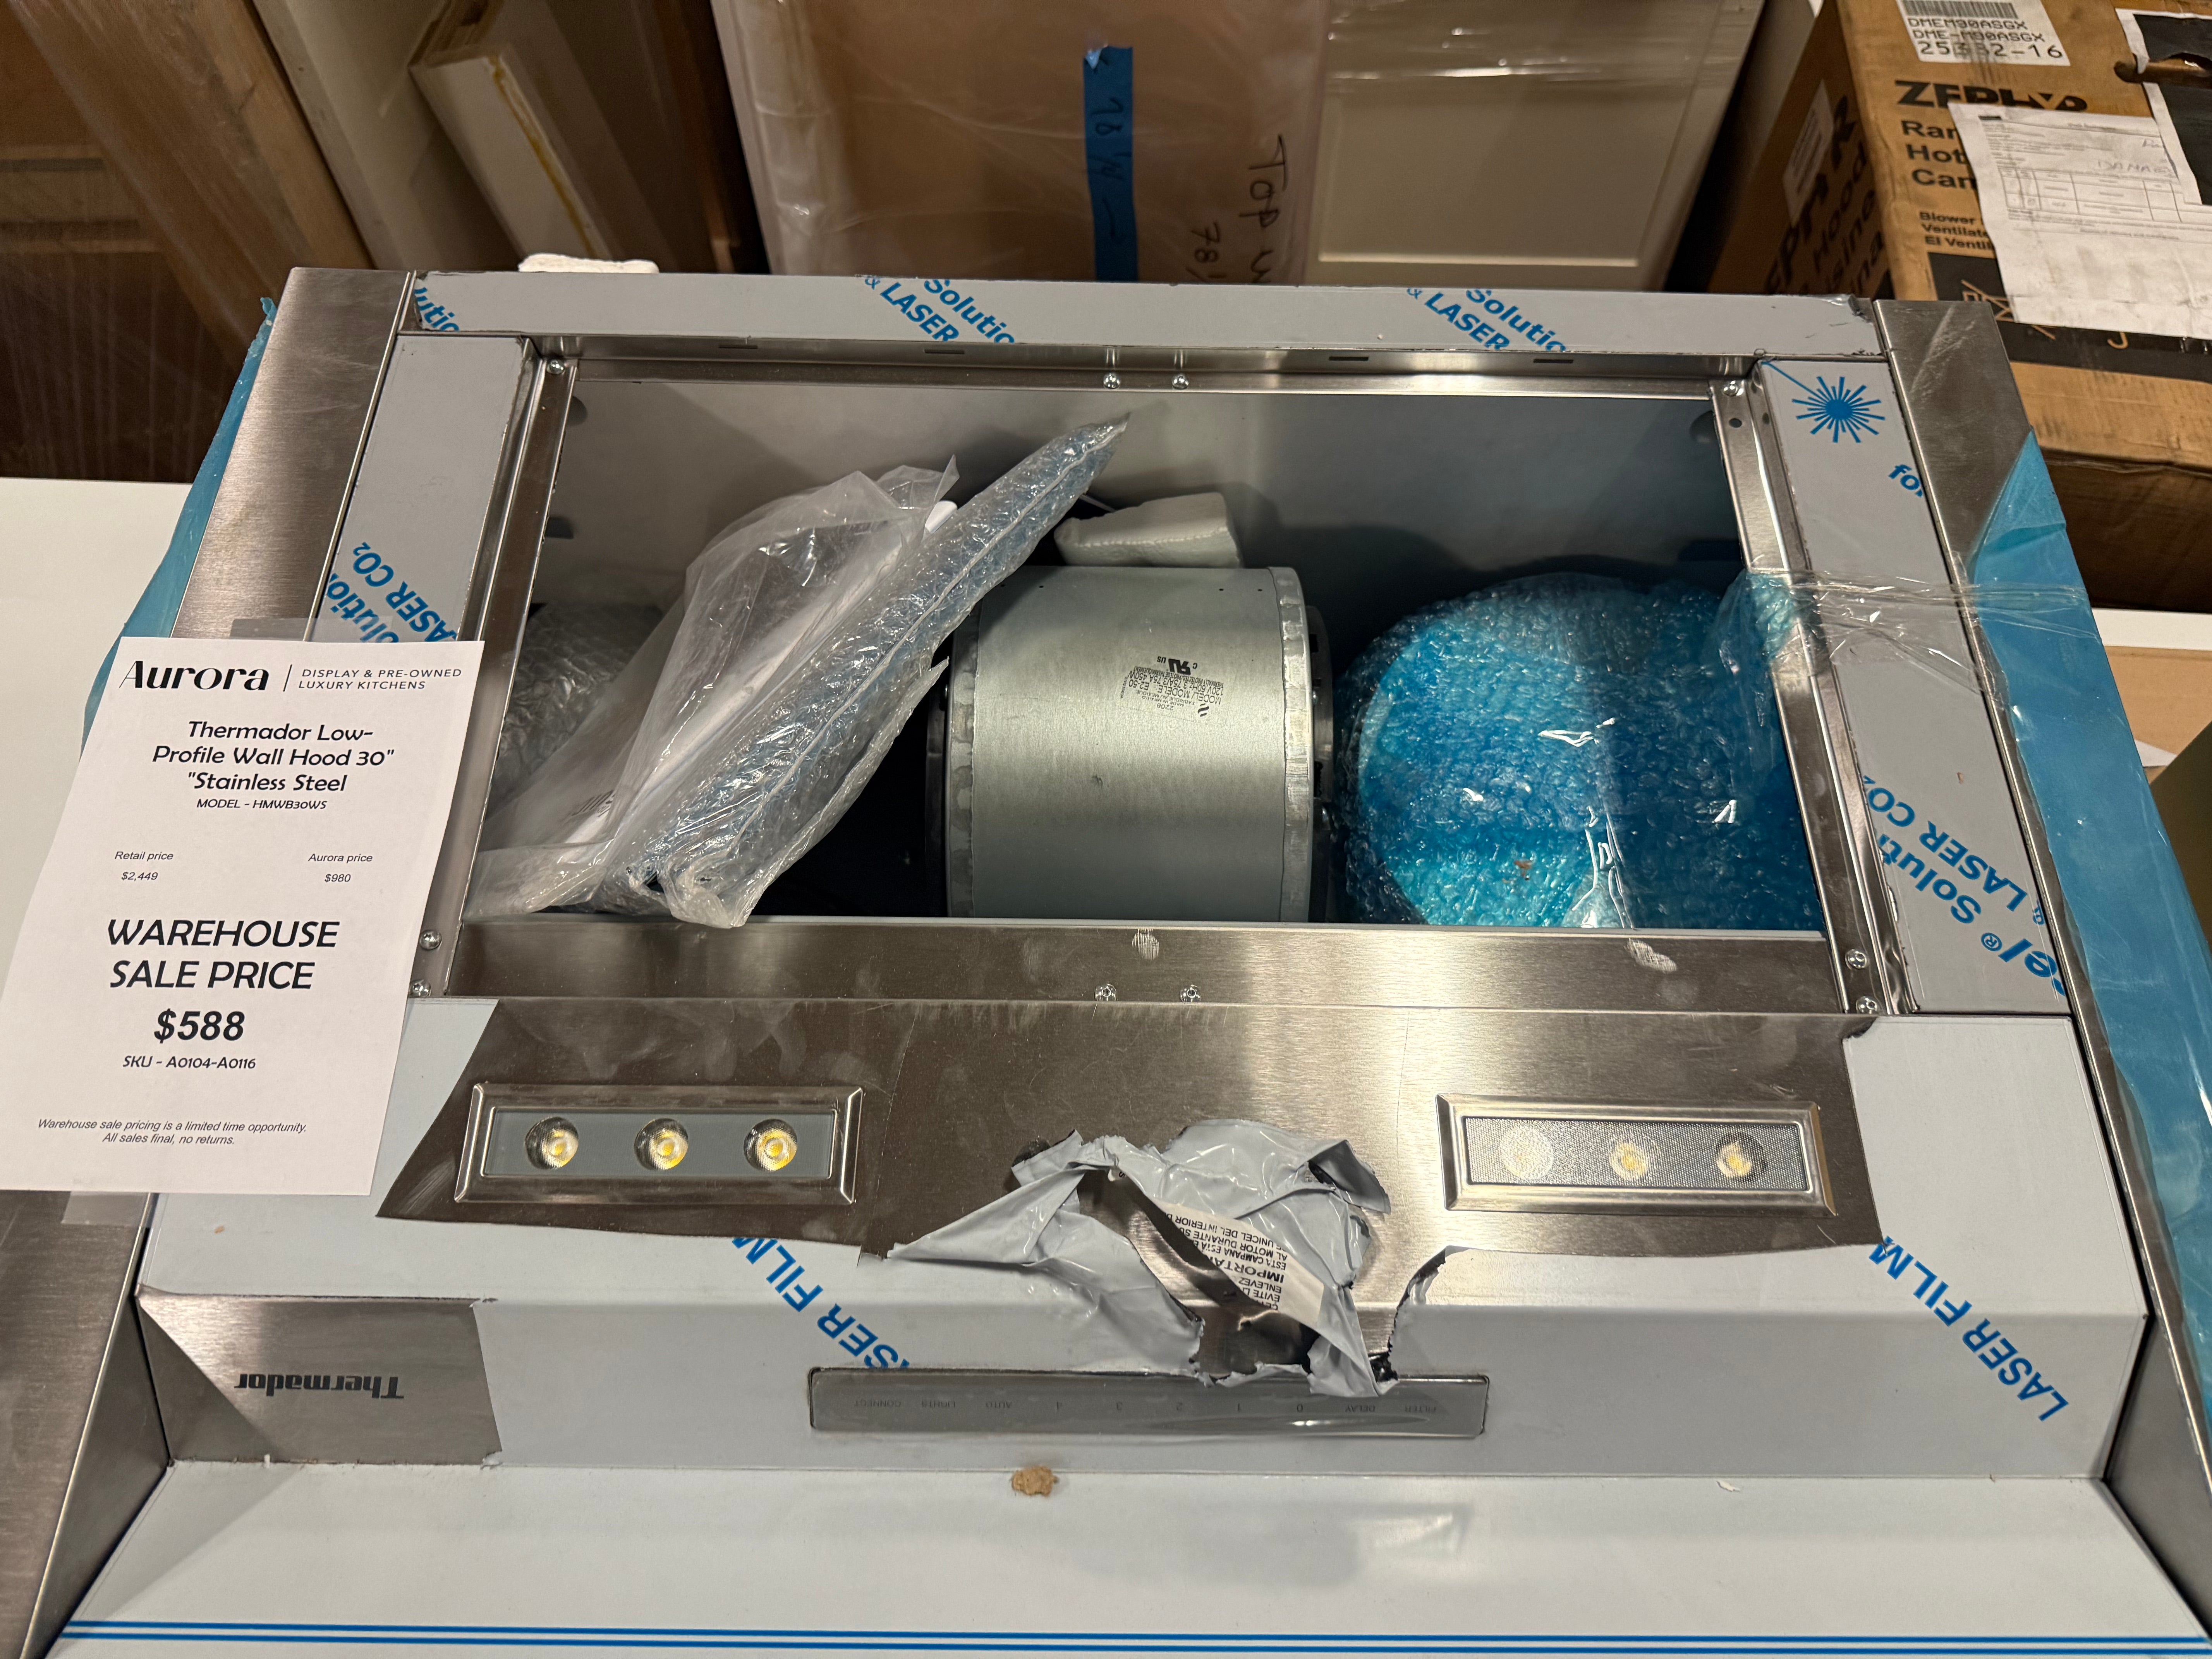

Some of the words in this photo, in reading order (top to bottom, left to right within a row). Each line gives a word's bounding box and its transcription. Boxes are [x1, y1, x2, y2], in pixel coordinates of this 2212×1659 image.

[1920, 212, 1975, 225] Blower
[880, 282, 960, 342] LASER
[1425, 292, 1510, 350] LASER
[119, 661, 269, 690] Aurora
[302, 669, 359, 678] DISPLAY
[364, 670, 372, 678] &
[378, 669, 461, 678] PRE-OWNED
[1128, 670, 1147, 680] 450W
[299, 680, 353, 689] LUXURY
[357, 681, 425, 689] KITCHENS
[1129, 679, 1149, 690] E2-50
[1207, 686, 1224, 696] 120V
[189, 721, 312, 740] Thermador
[317, 725, 373, 741] Low-
[152, 745, 225, 763] Profile
[234, 747, 284, 765] Wall
[289, 749, 352, 766] Hood
[356, 749, 395, 766] 30"
[188, 772, 286, 790] "Stainless
[293, 774, 348, 791] Steel
[197, 799, 240, 808] MODEL
[252, 800, 327, 809] HMWB30WS
[114, 851, 146, 860] Retail
[147, 854, 173, 862] price
[307, 854, 343, 862] Aurora
[346, 855, 373, 864] price
[1919, 820, 2027, 912] LASER
[121, 871, 158, 881] $2,449
[325, 874, 351, 883] $980
[108, 919, 340, 947] WAREHOUSE
[110, 960, 199, 988] SALE
[207, 961, 315, 989] PRICE
[154, 1008, 245, 1044] $588
[123, 1055, 153, 1067] SKU
[38, 1119, 97, 1129] Warehouse
[100, 1120, 122, 1129] sale
[124, 1122, 161, 1132] pricing
[185, 1121, 222, 1131] limited
[223, 1122, 245, 1131] time
[248, 1123, 306, 1134] opportunity.
[102, 1133, 118, 1142] All
[119, 1133, 148, 1143] sales
[150, 1133, 175, 1145] final,
[195, 1135, 234, 1144] returns.
[1175, 1216, 1218, 1233] INTERIOR
[1220, 1226, 1238, 1238] DEL
[1193, 1231, 1237, 1249] DURANTE
[1241, 1232, 1274, 1247] UNICEL
[1224, 1247, 1264, 1264] CAMPANA
[1240, 1243, 1273, 1258] MOTOR
[1276, 1252, 1287, 1261] AL
[732, 1237, 823, 1312] FILM
[1869, 1235, 1972, 1327] FILM
[1962, 1318, 2069, 1421] LASER
[234, 1373, 404, 1399] Thermador
